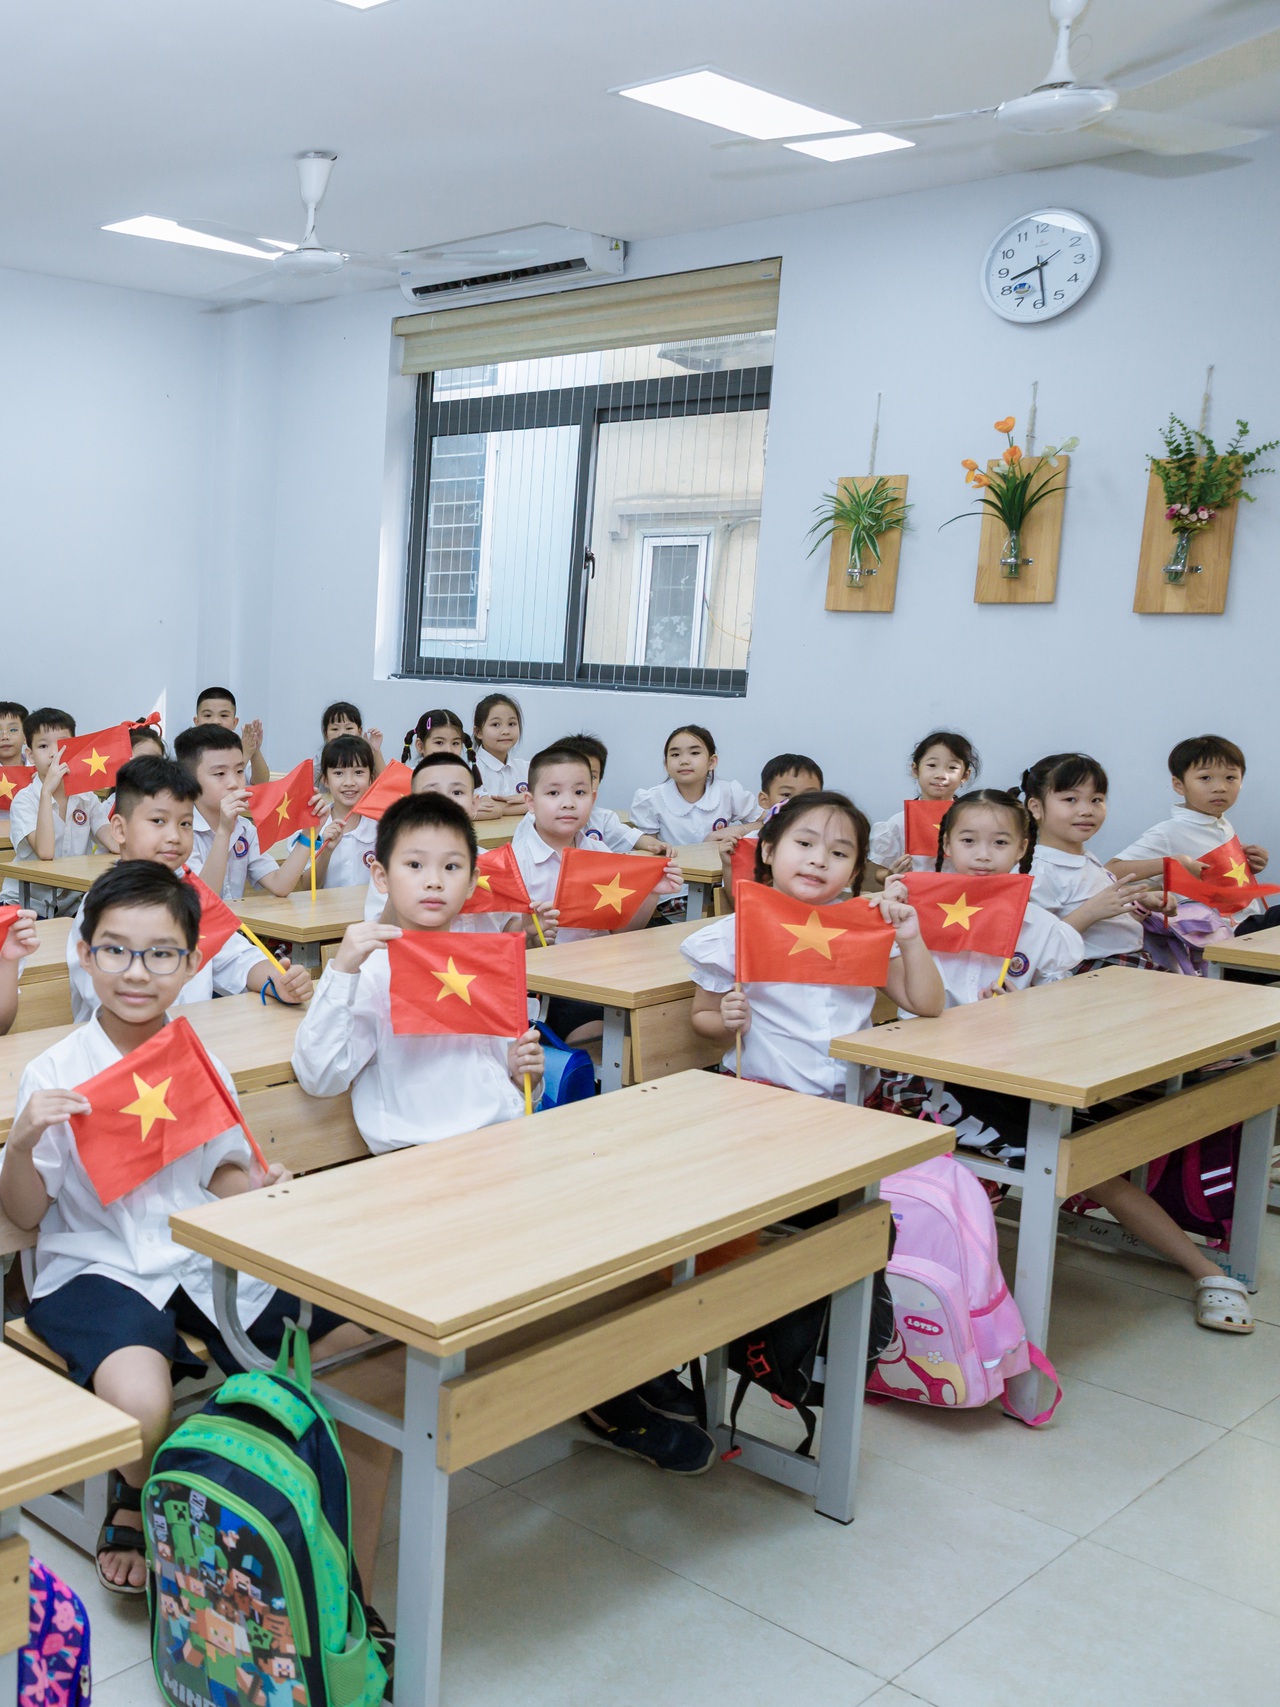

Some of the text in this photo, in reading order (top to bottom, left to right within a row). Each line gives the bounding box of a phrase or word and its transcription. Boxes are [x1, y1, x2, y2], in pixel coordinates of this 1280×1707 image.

[1035, 222, 1050, 234] 12
[1017, 231, 1028, 242] 11
[1069, 236, 1082, 248] 2
[1001, 248, 1015, 260] 10
[1073, 253, 1086, 264] 3
[998, 268, 1009, 278] 9
[1067, 273, 1079, 283] 4
[1001, 285, 1013, 296] 8
[1053, 289, 1065, 300] 5
[1014, 297, 1024, 307] 7
[1033, 299, 1045, 309] 6
[907, 1318, 939, 1333] LOTSO
